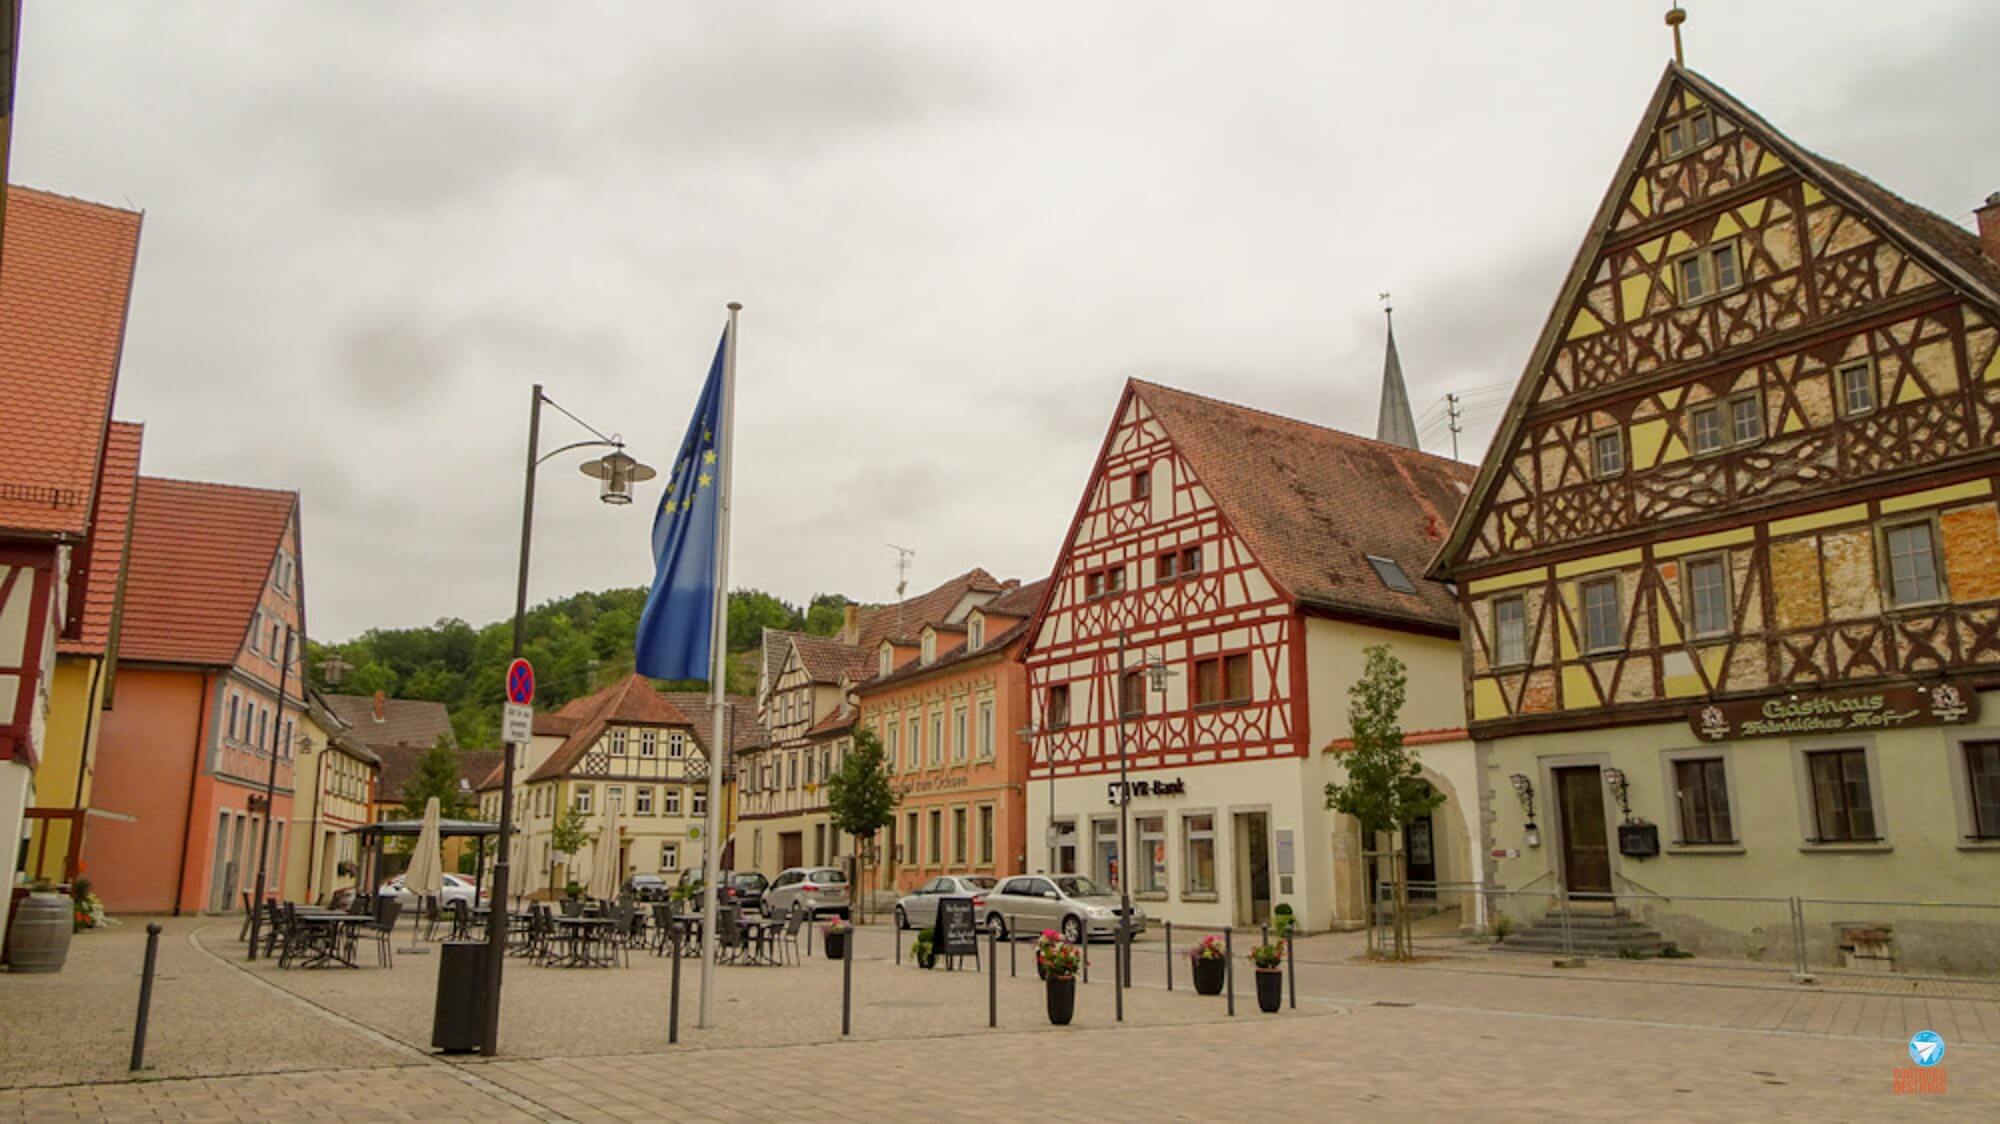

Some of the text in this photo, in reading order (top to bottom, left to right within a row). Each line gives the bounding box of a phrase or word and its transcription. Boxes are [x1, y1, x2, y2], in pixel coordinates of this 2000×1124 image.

[1761, 694, 1885, 719] Gasthaus
[1847, 709, 1920, 730] Hof
[1131, 777, 1185, 797] VR-Bank
